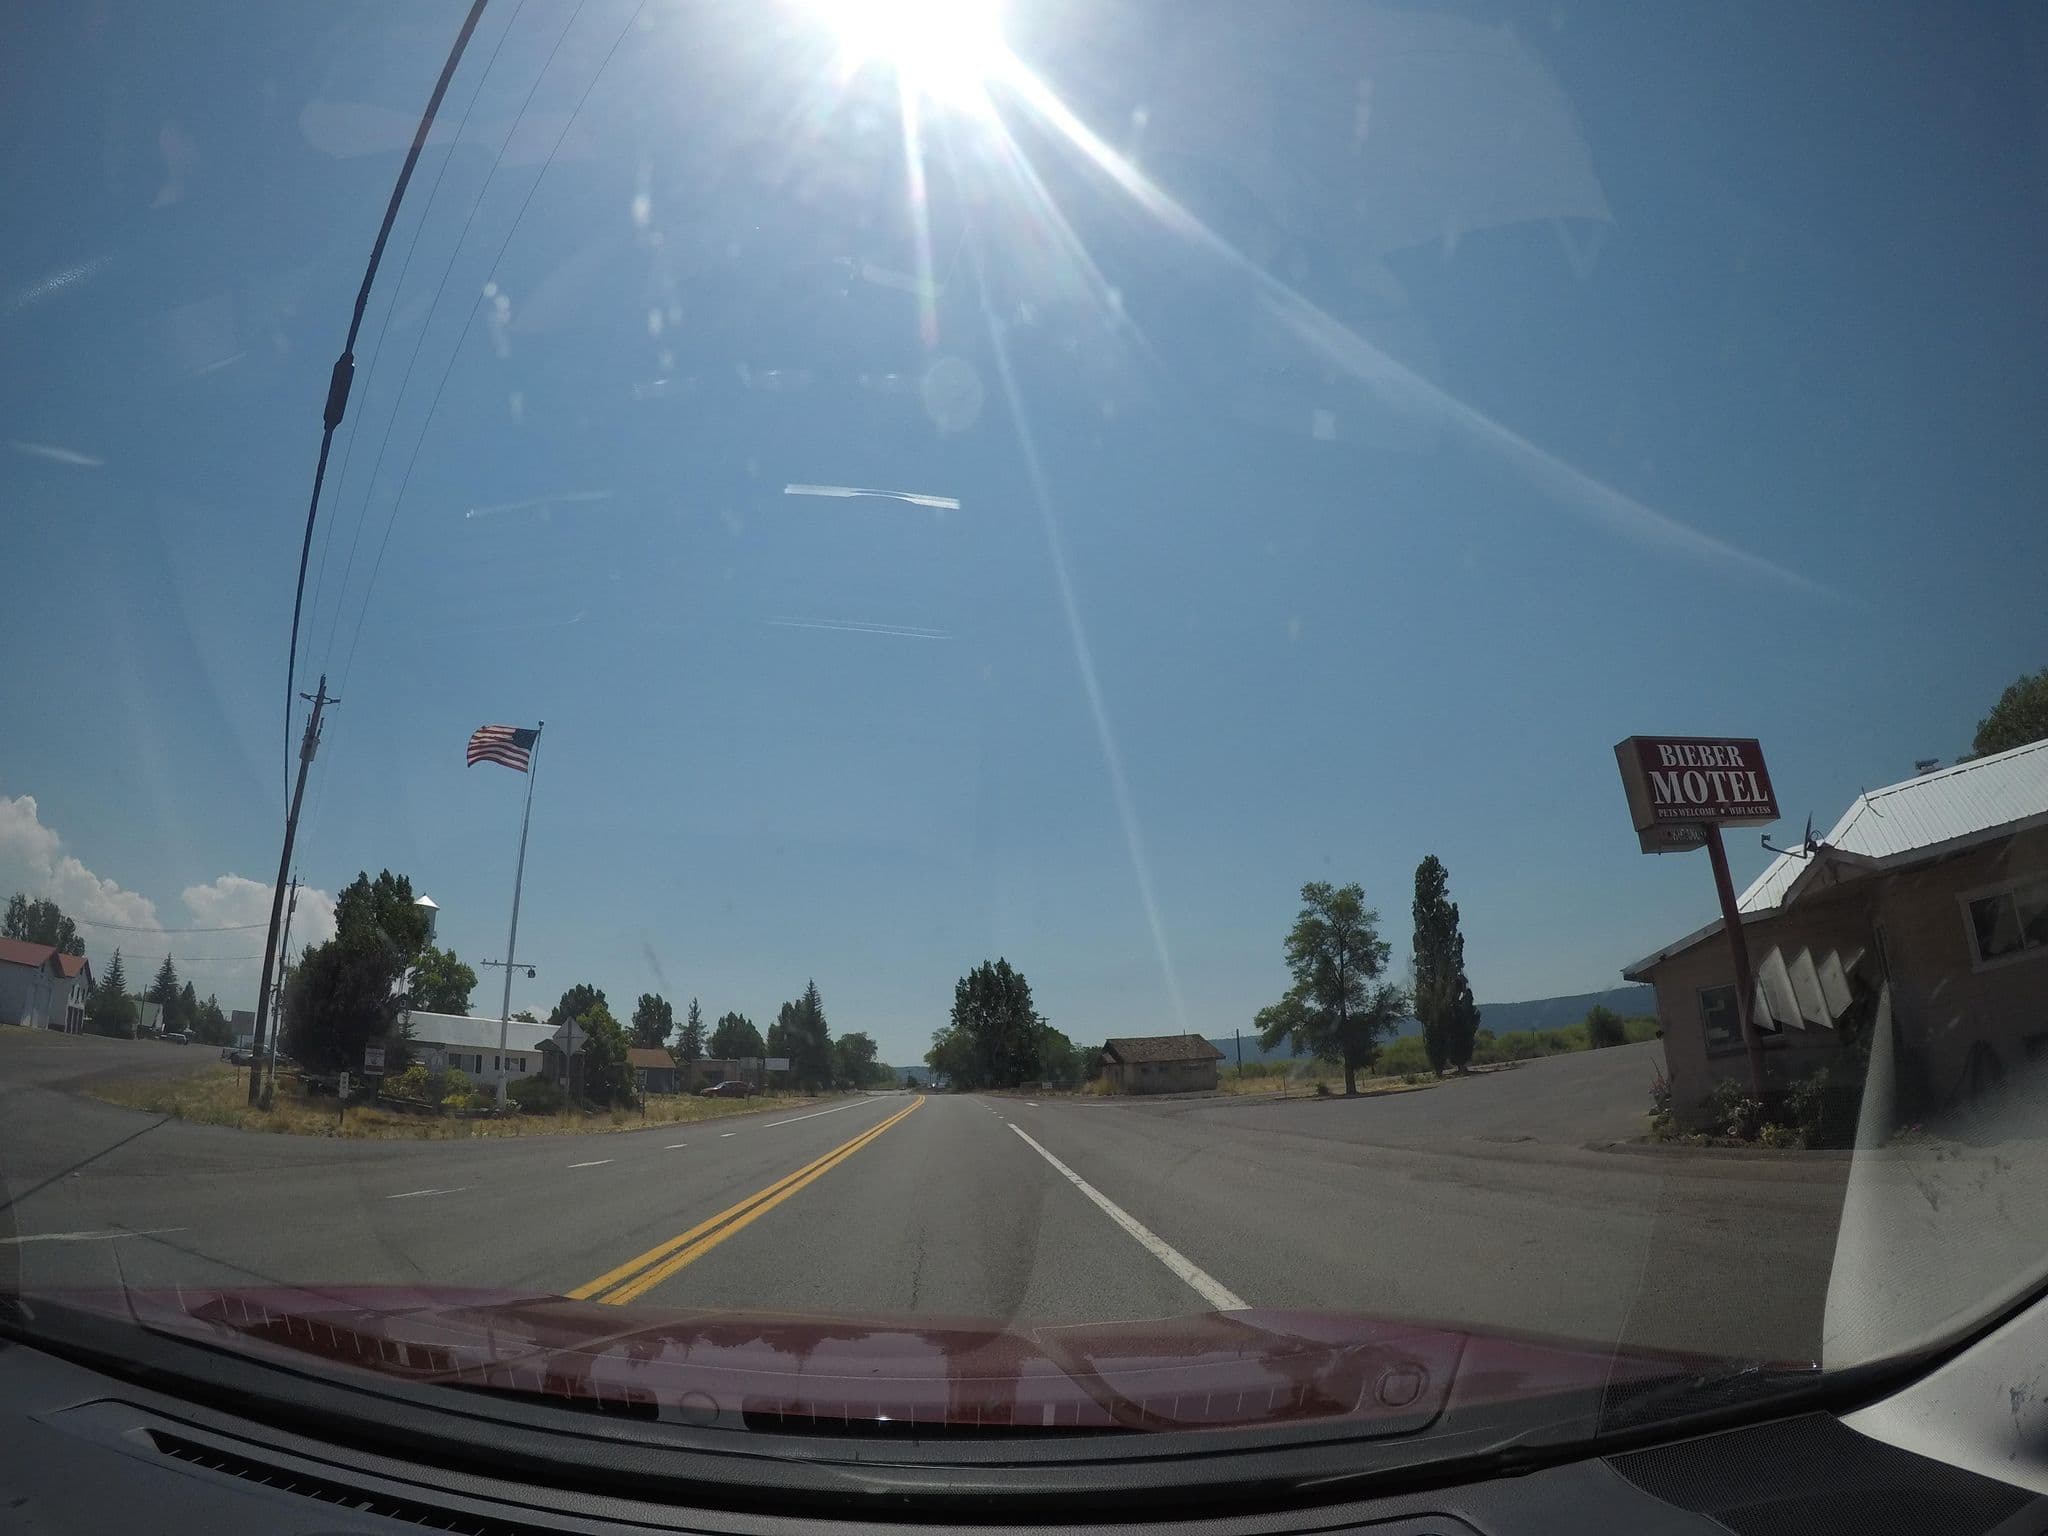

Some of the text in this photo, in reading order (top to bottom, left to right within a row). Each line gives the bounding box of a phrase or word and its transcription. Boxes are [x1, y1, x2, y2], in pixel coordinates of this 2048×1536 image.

[1657, 744, 1744, 767] BIEBER
[1649, 771, 1768, 804] MOTEL
[1658, 808, 1716, 817] PETS WELCOME
[1747, 806, 1771, 815] ACCESS
